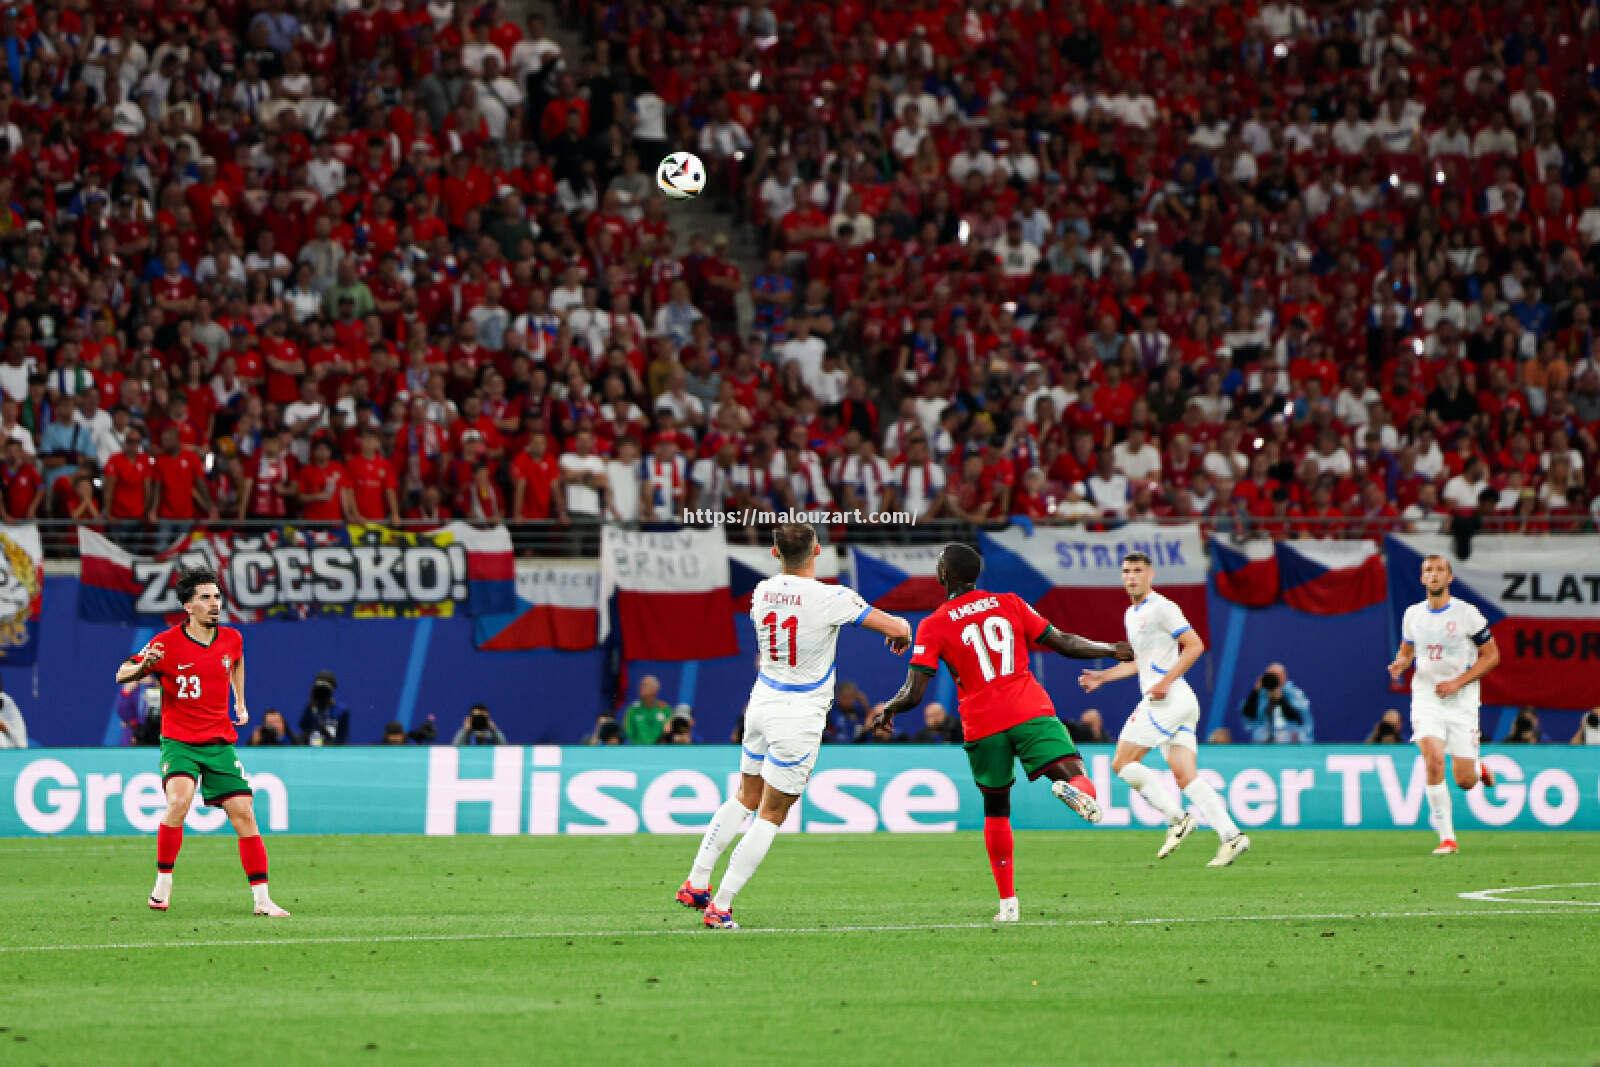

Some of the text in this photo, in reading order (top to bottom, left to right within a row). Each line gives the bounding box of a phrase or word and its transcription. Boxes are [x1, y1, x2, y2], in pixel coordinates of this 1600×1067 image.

[762, 611, 799, 668] 11
[961, 615, 1015, 683] 19
[176, 674, 202, 699] 23
[1326, 754, 1428, 826] TV
[1466, 753, 1580, 827] Go
